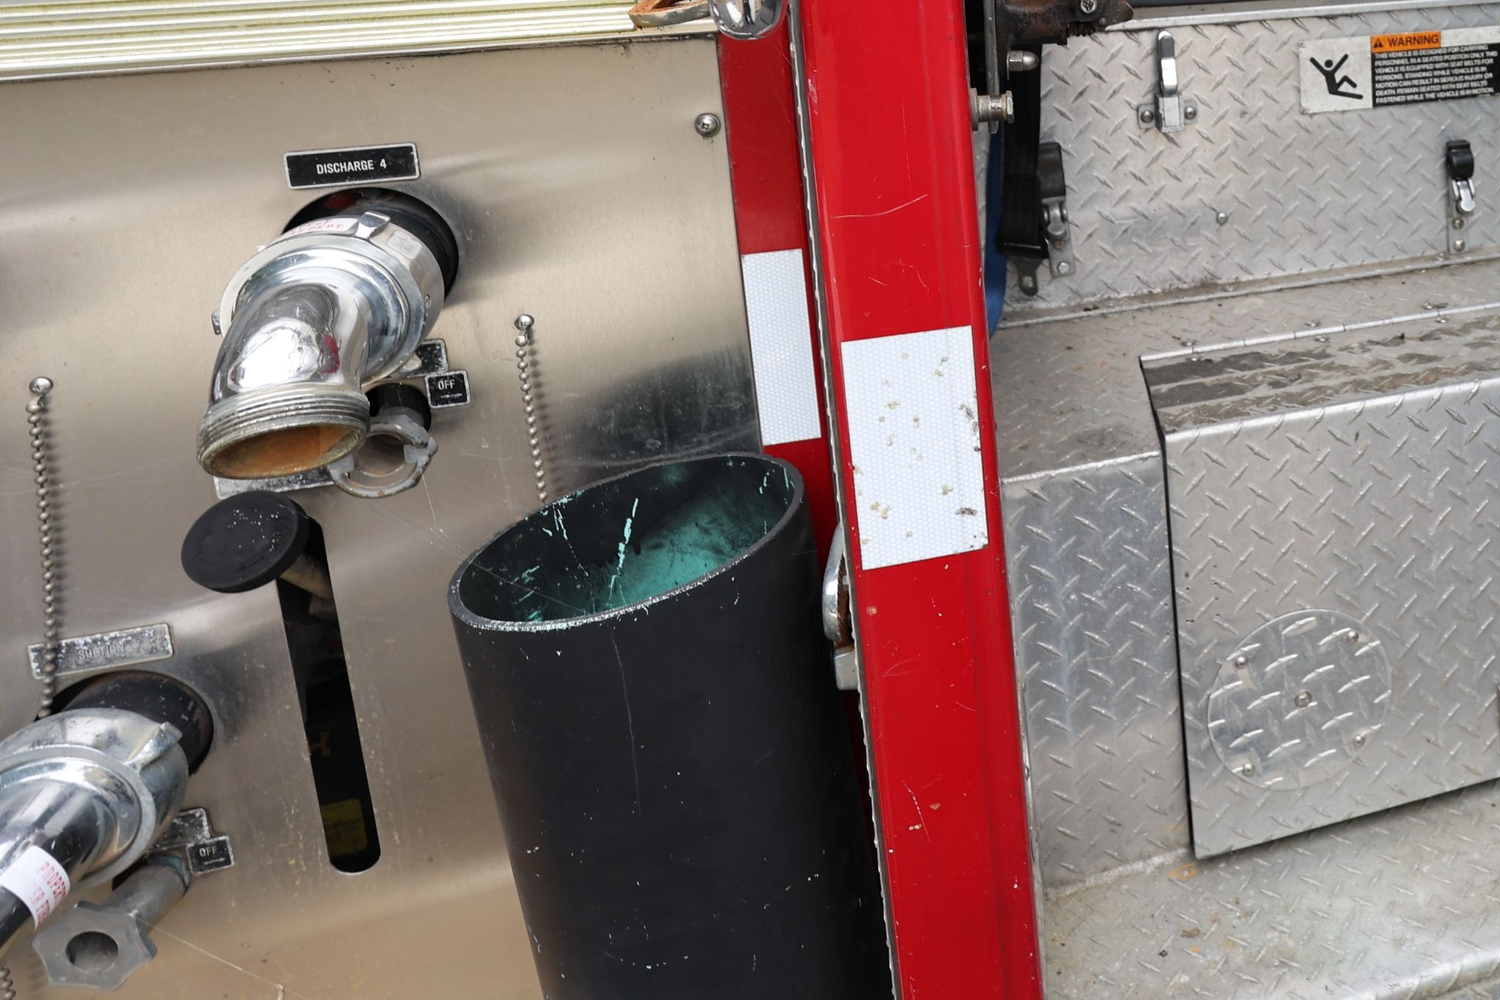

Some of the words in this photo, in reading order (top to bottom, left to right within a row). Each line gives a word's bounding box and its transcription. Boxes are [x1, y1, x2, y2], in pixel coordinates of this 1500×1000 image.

[1387, 34, 1439, 47] WARNING
[1388, 50, 1412, 58] VEHICLE
[1419, 47, 1447, 56] DESIGNED
[1460, 44, 1488, 52] CARRYING
[1375, 58, 1410, 67] PERSONNEL
[1421, 54, 1444, 62] SEATED
[1443, 52, 1470, 61] POSITION
[1375, 66, 1400, 74] VEHICLE
[1406, 63, 1434, 72] EQUIPPED
[1449, 60, 1464, 68] SEAT
[1463, 59, 1481, 67] BELTS
[1404, 70, 1433, 79] STANDING
[1432, 68, 1451, 76] WHILE
[1451, 67, 1474, 75] VEHICLE
[1375, 81, 1399, 89] MOTION
[1398, 79, 1412, 87] CAN
[1411, 77, 1433, 86] RESULT
[1440, 74, 1464, 83] SERIOUS
[1464, 73, 1484, 81] INJURY
[1396, 86, 1420, 95] REMAIN
[1420, 84, 1441, 93] SEATED
[1441, 82, 1456, 90] WITH
[1455, 81, 1470, 89] SEAT
[1470, 80, 1488, 88] BELTS
[1375, 95, 1406, 104] FASTENED
[1406, 93, 1425, 101] WHILE
[1437, 90, 1460, 98] VEHICLE
[316, 160, 374, 175] DISCHARGE
[379, 158, 388, 169] 4
[437, 379, 456, 391] OFF
[199, 845, 219, 858] OFF
